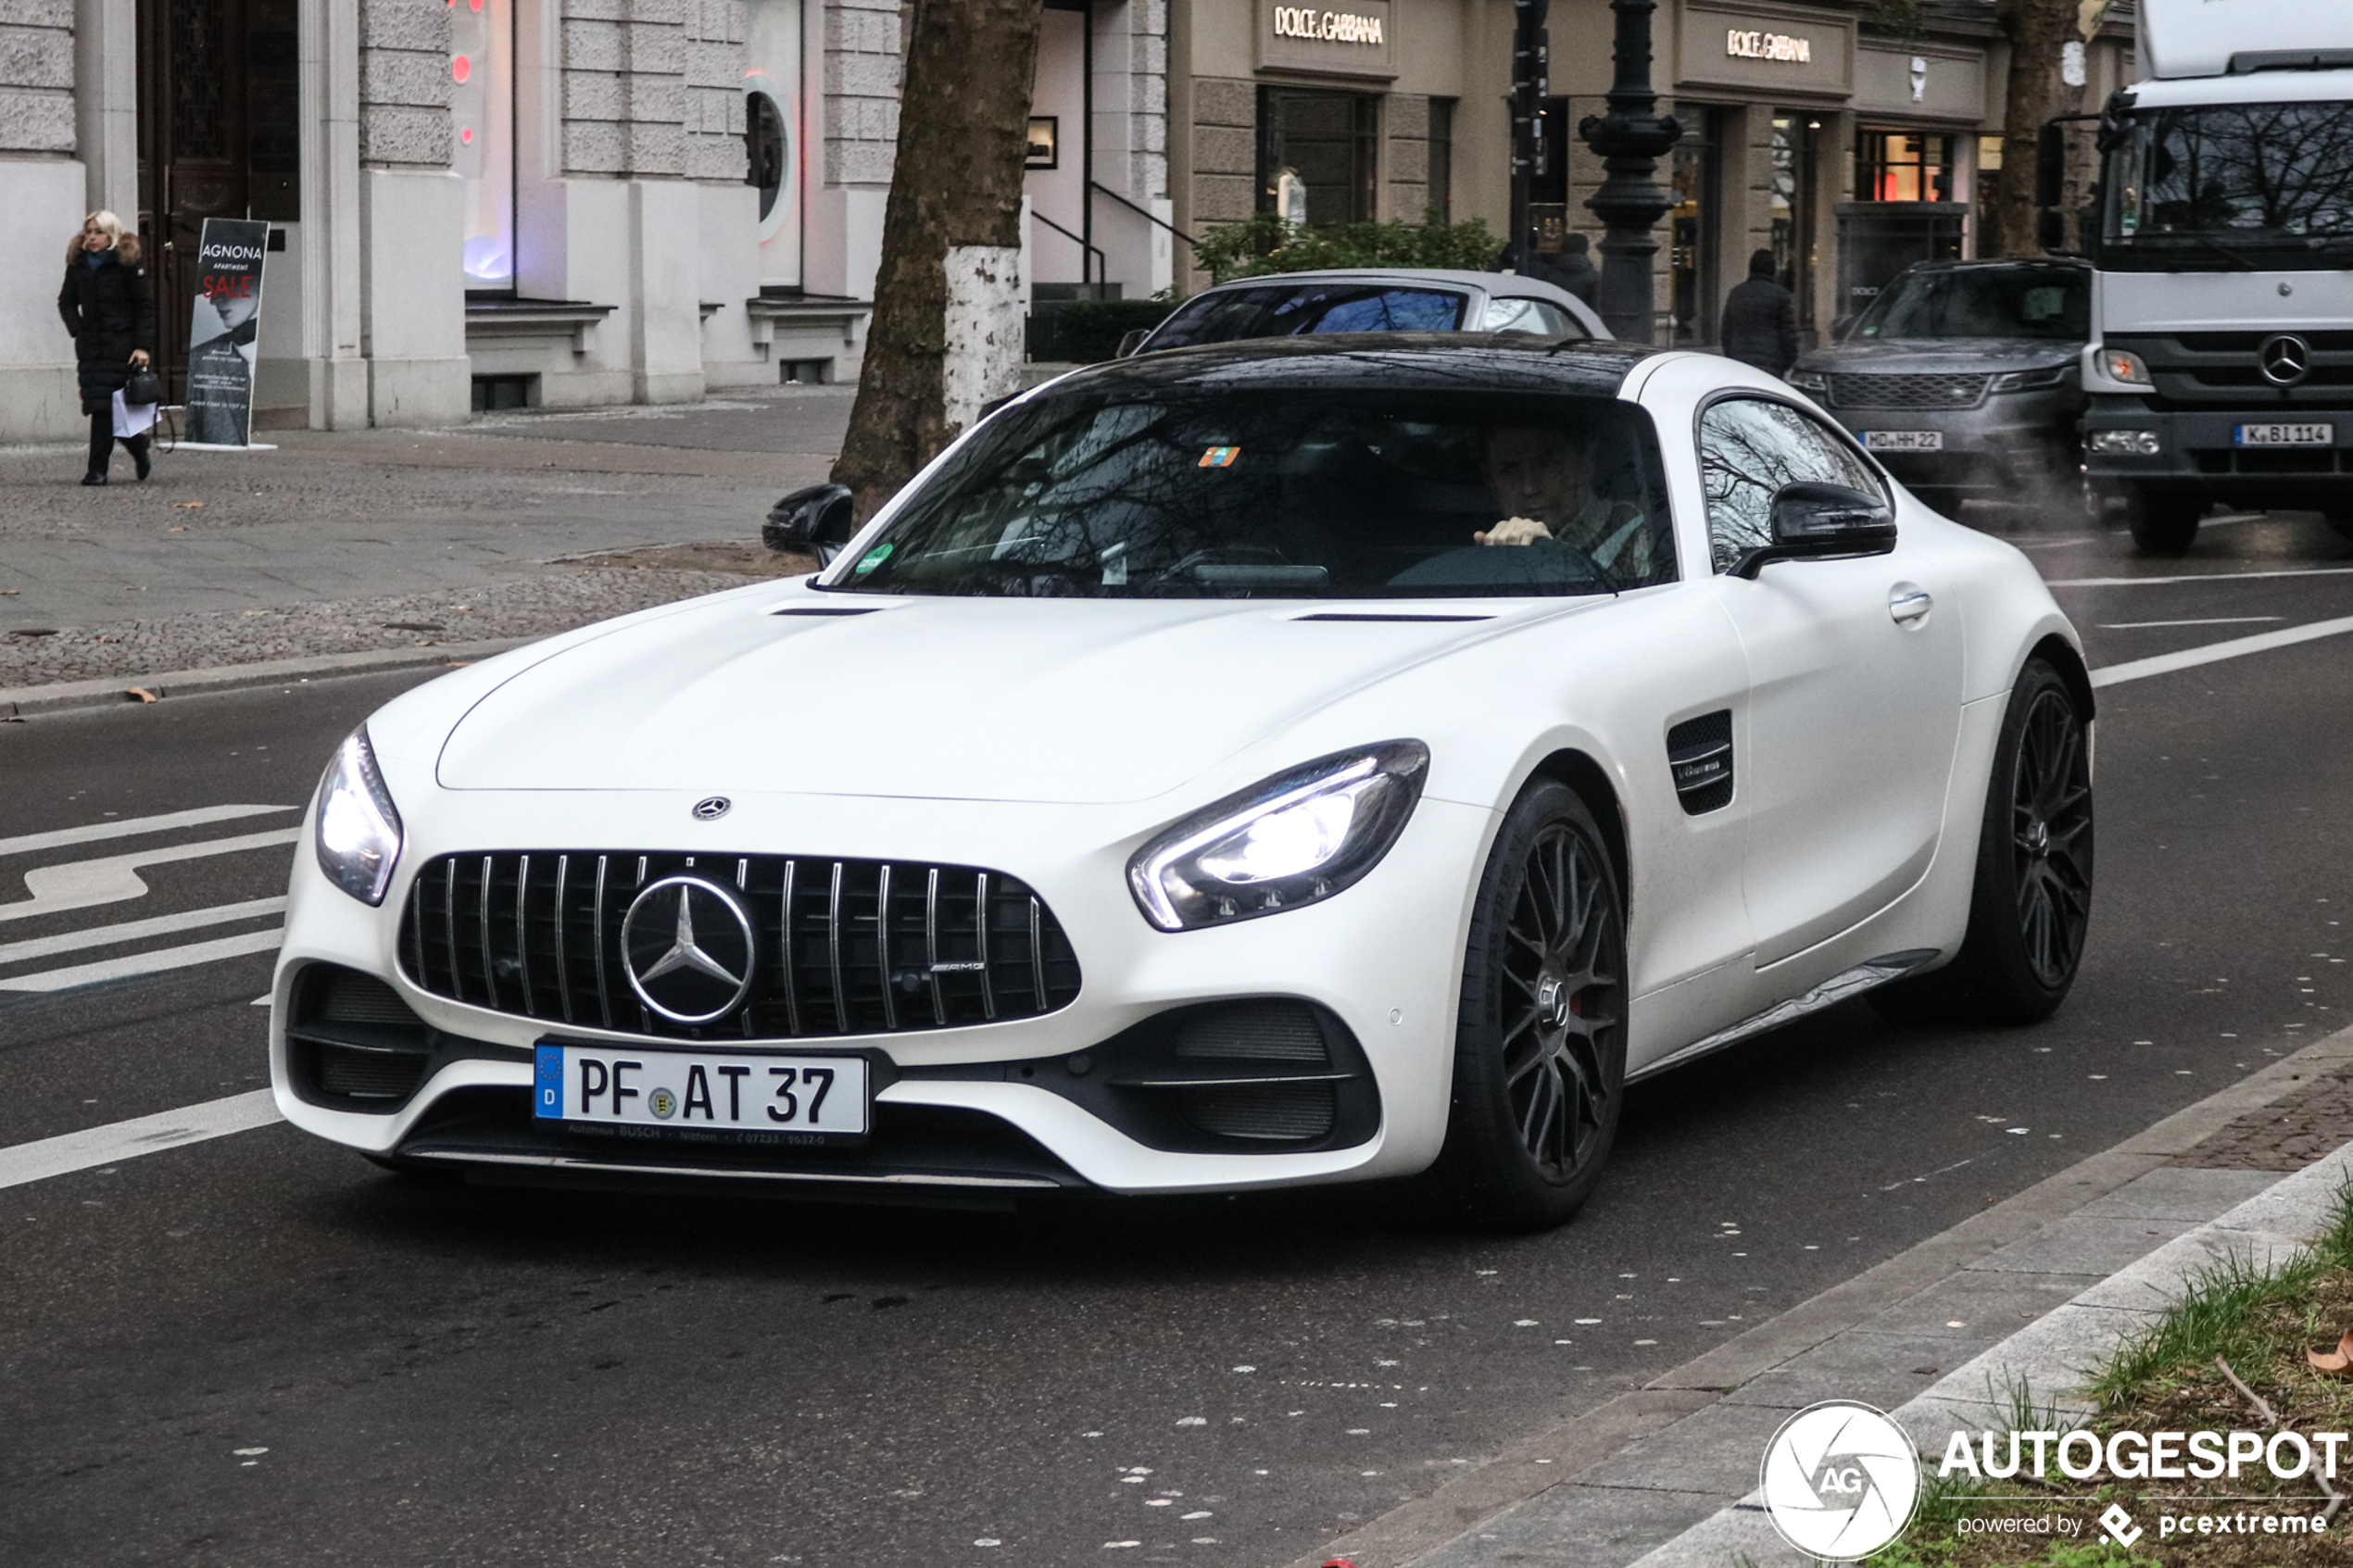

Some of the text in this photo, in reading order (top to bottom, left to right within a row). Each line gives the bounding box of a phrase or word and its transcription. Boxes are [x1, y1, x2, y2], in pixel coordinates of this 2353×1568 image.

[202, 245, 262, 259] AGNONA
[203, 275, 253, 298] SALE
[1919, 433, 1936, 447] 22
[2248, 426, 2324, 442] K BI 114
[946, 962, 985, 971] AMG
[544, 1088, 555, 1105] D
[579, 1058, 836, 1123] PF AT 37
[568, 1123, 614, 1135] Autohaus
[619, 1125, 661, 1138] BUSCH
